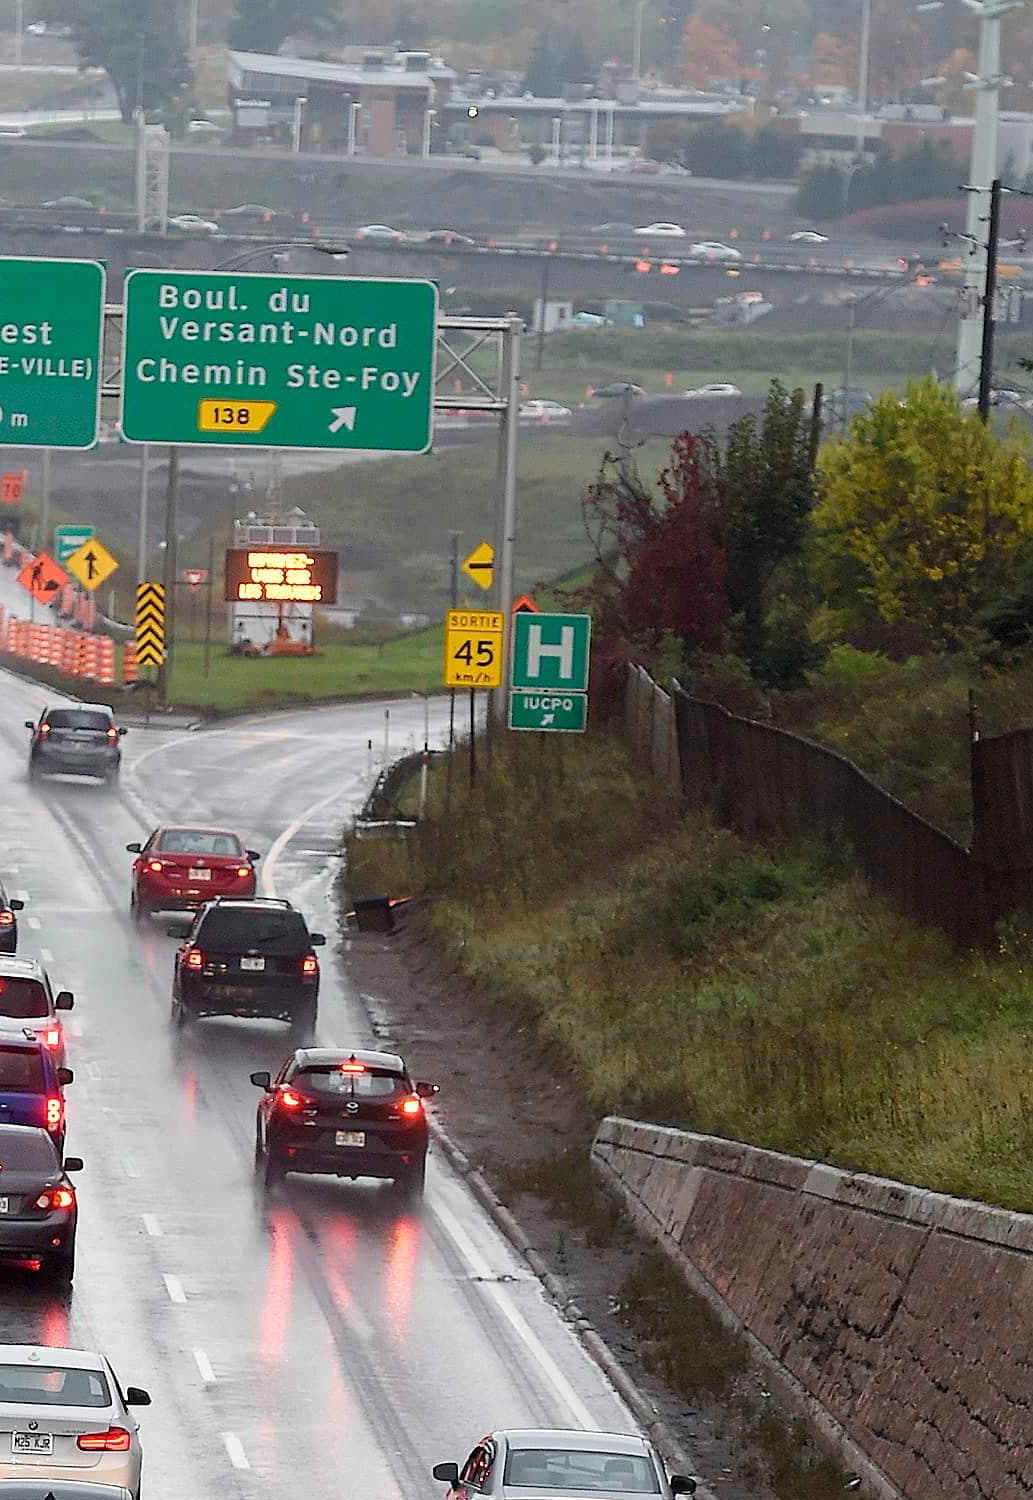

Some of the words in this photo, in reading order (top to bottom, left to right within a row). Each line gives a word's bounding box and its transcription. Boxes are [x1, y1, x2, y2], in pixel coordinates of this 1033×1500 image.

[159, 284, 248, 311] Boul.
[269, 287, 310, 313] du
[159, 316, 398, 348] Versant-Nord
[136, 358, 267, 386] Chemin
[286, 364, 421, 397] Ste-Foy
[10, 411, 29, 427] m
[213, 407, 251, 425] 138
[451, 615, 500, 628] SORTIE
[454, 639, 494, 667] 45
[526, 624, 575, 679] H
[455, 672, 491, 683] km/h
[523, 697, 574, 712] IUCPQ
